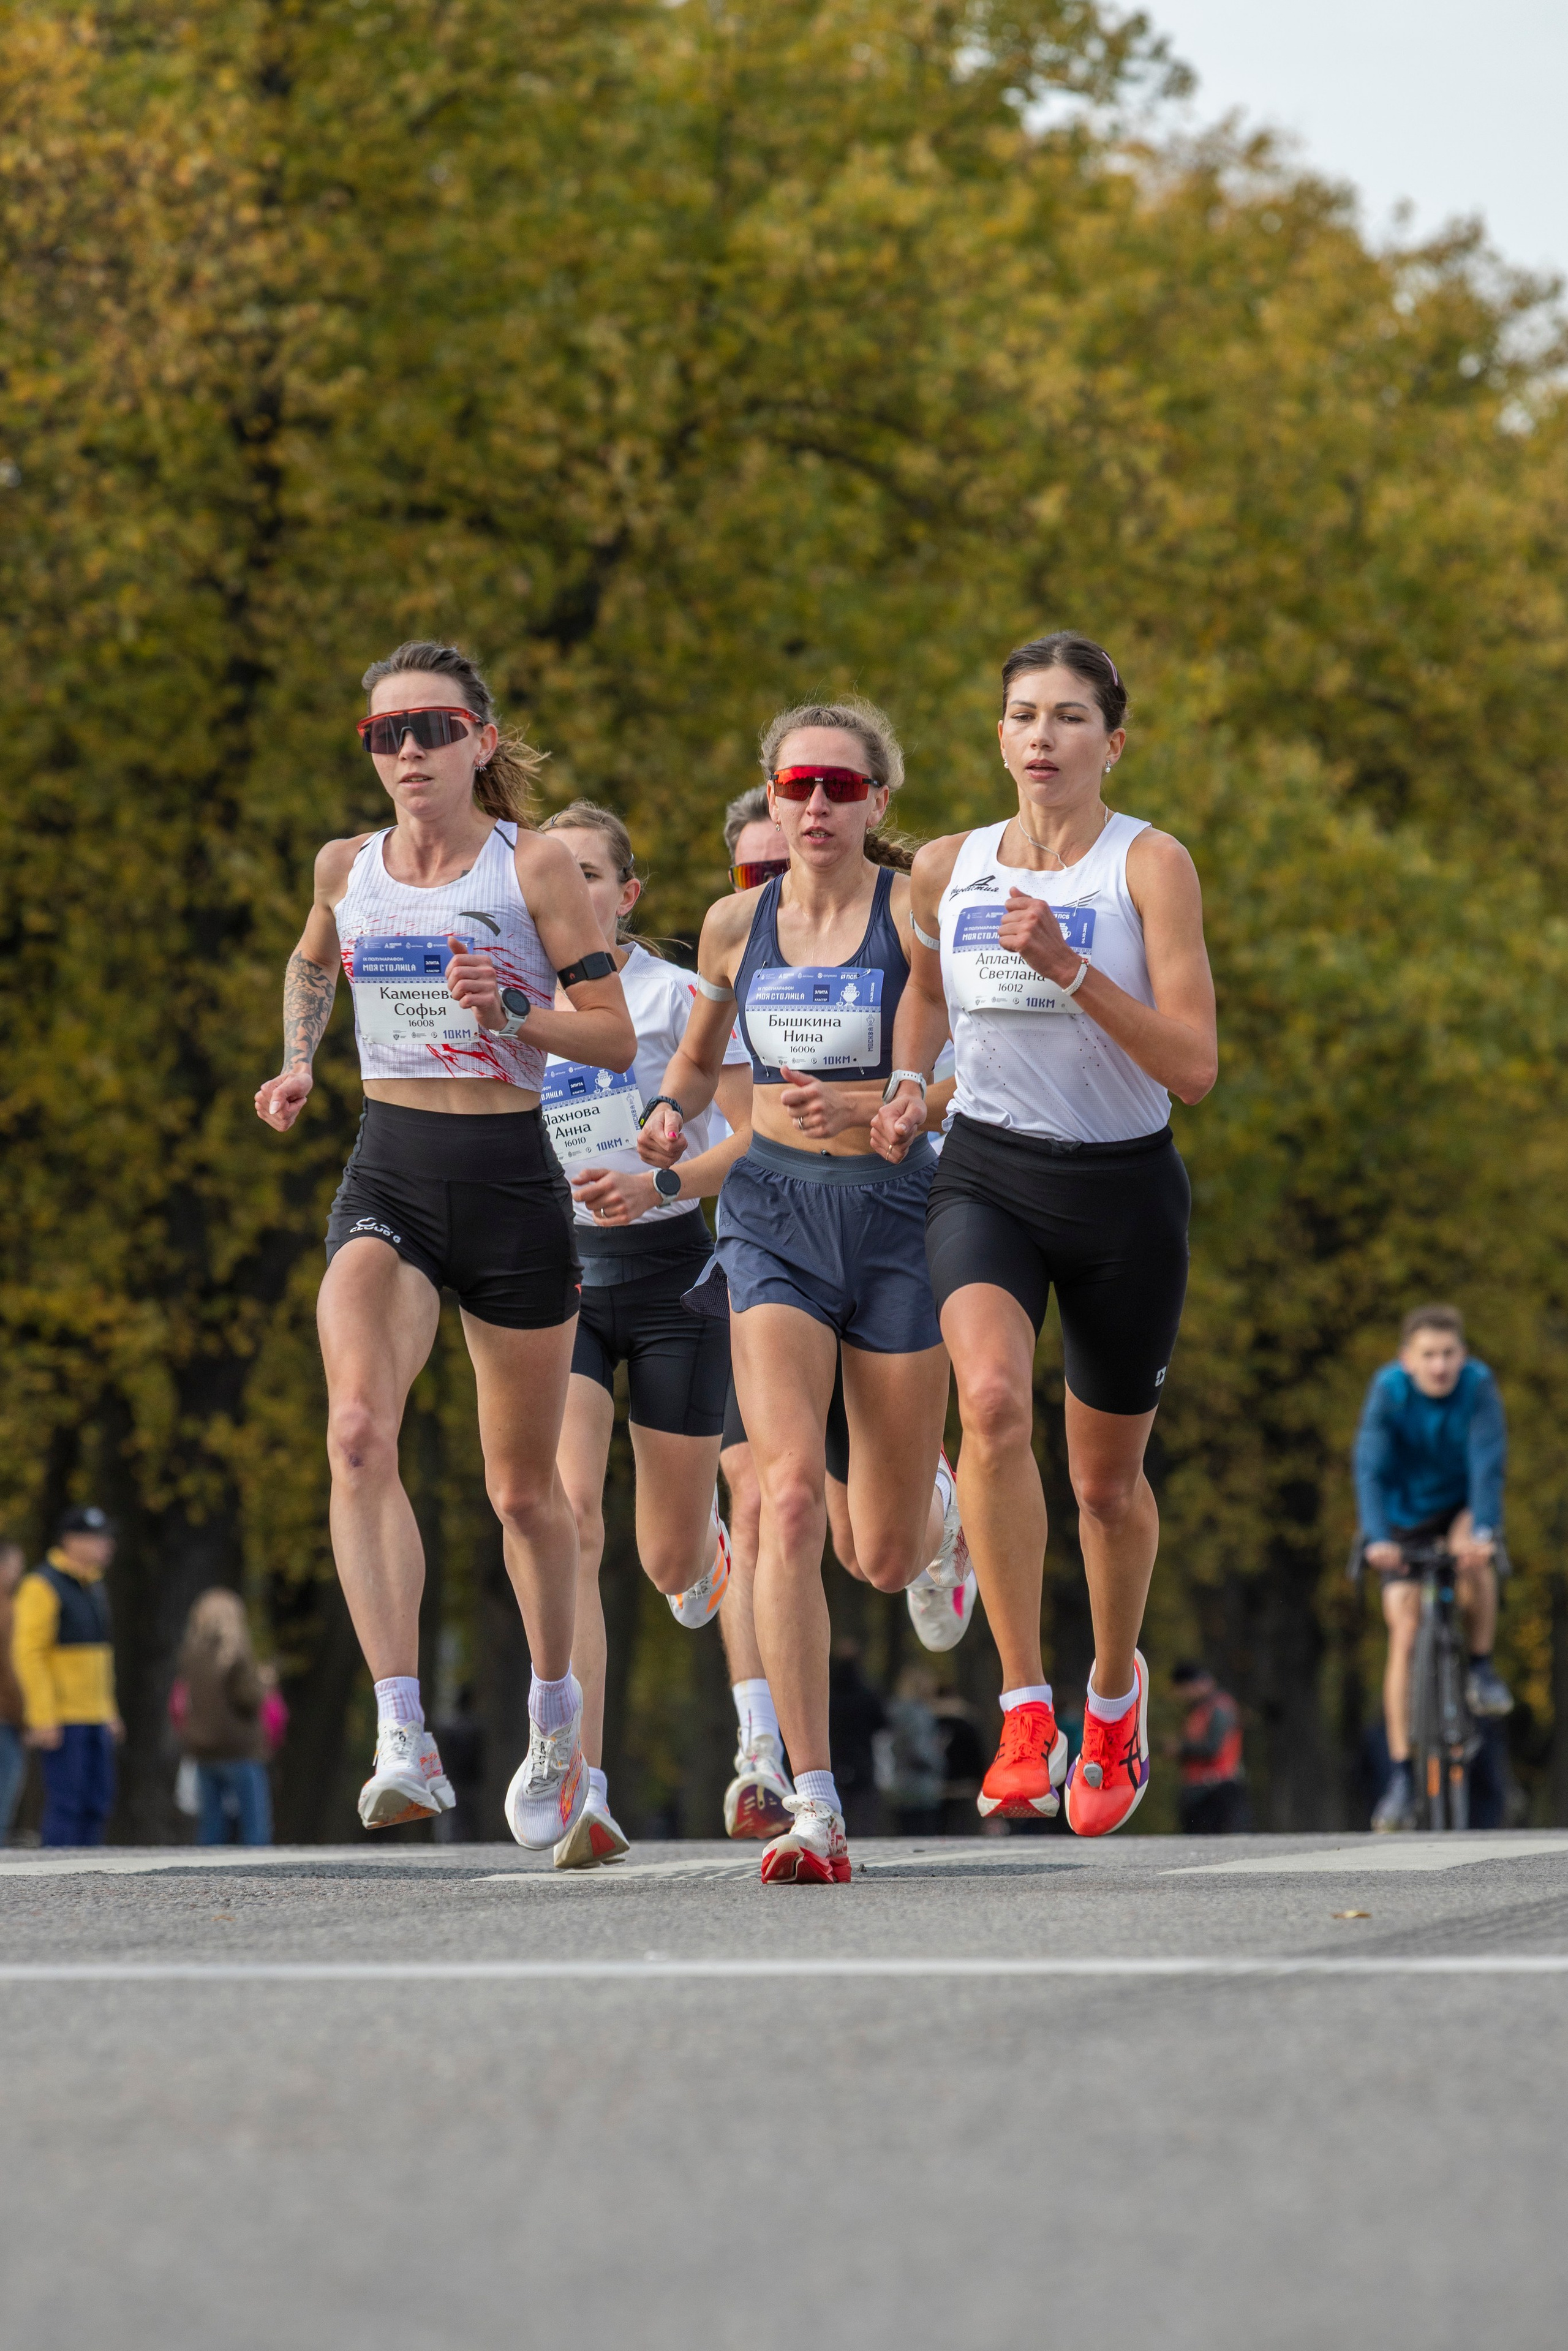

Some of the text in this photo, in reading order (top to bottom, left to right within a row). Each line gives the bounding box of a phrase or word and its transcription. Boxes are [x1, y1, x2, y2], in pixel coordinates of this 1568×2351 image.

[962, 932, 1000, 941] МОЯ СТОЛ
[976, 953, 1028, 965] Аплачк
[379, 964, 417, 972] СТОЛИЦА
[979, 967, 1046, 982] Светлана
[380, 987, 453, 1000] Каменев
[998, 983, 1023, 992] 16012
[1026, 997, 1055, 1008] 10КМ
[394, 1003, 447, 1019] Софья
[769, 1014, 842, 1027] Бышкина
[443, 1029, 471, 1039] 10КМ
[784, 1030, 823, 1043] Нина
[823, 1055, 850, 1065] 10КМ
[541, 1090, 563, 1101] ОЛИЦА
[630, 1104, 641, 1131] МОСКВА
[556, 1123, 592, 1139] Анна
[565, 1136, 586, 1147] 16010
[596, 1138, 622, 1151] 10КМ
